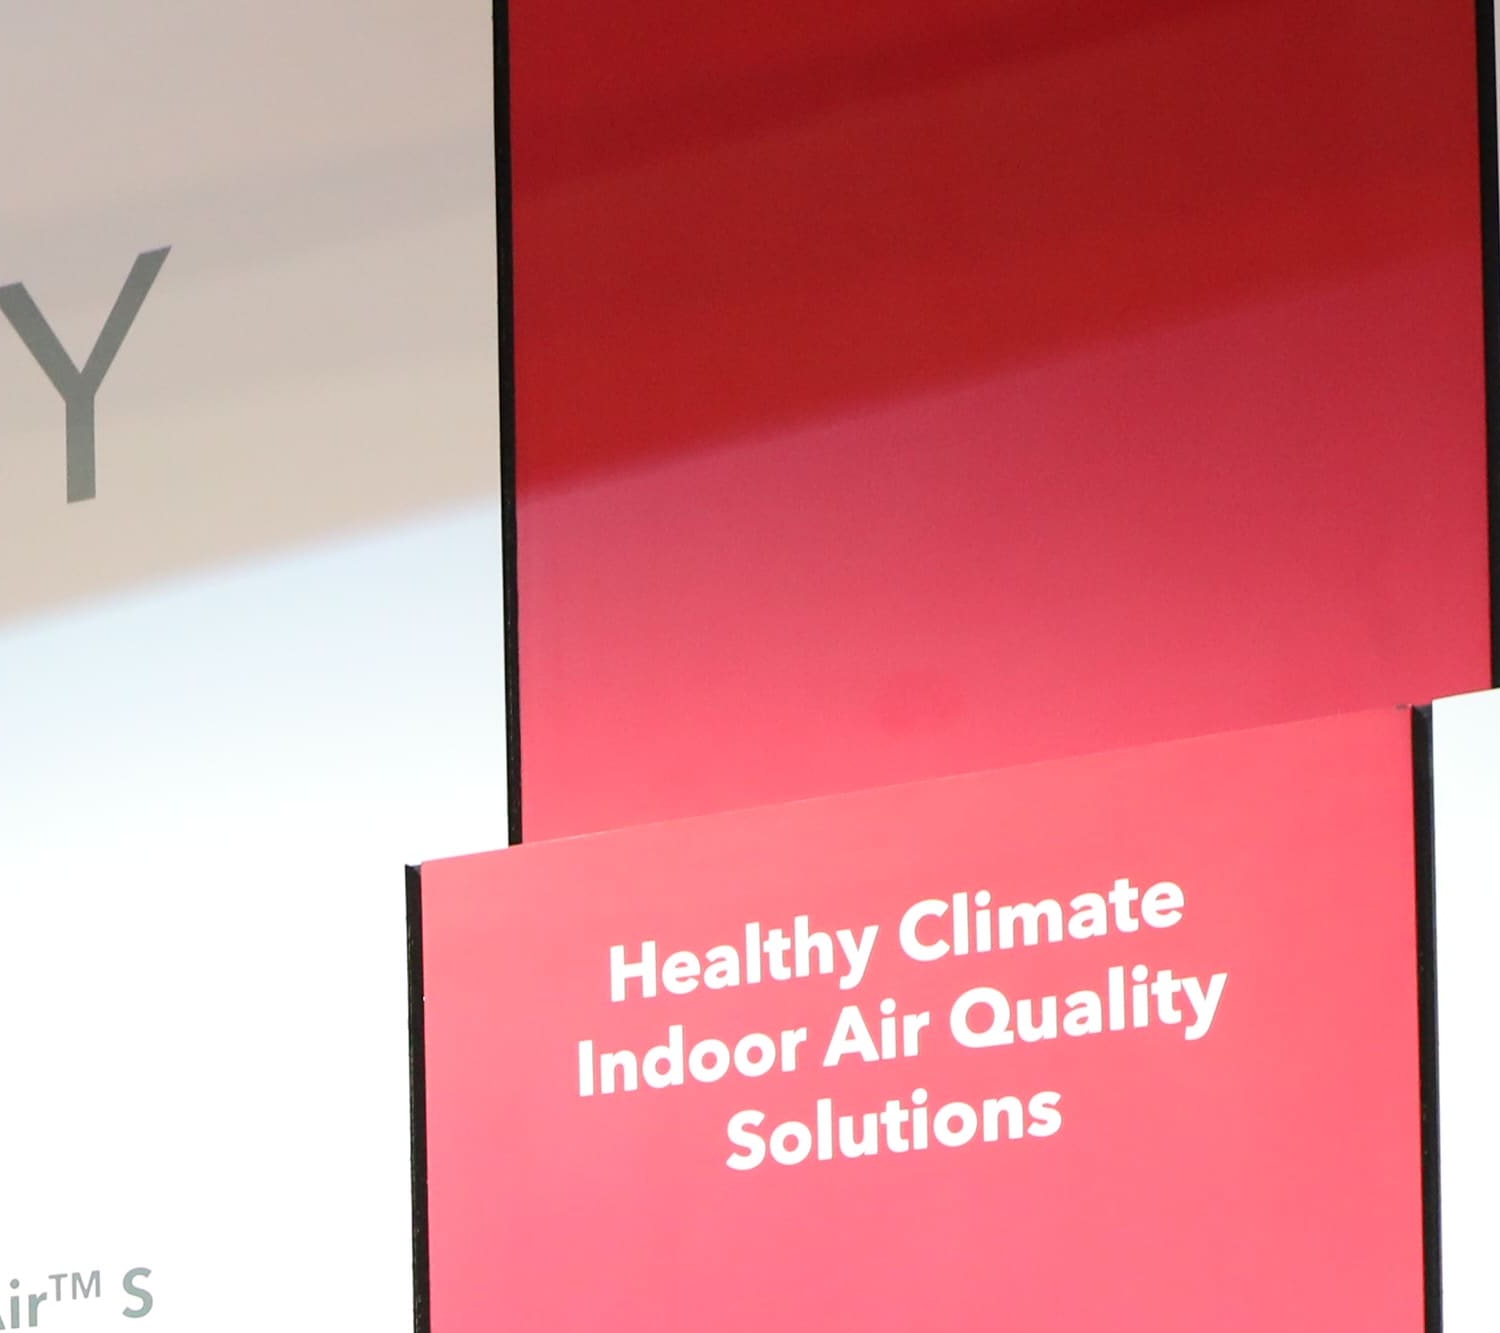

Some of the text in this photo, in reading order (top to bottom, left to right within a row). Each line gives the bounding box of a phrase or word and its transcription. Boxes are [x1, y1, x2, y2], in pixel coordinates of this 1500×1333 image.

[609, 878, 1185, 1003] Healthy Climate
[577, 963, 1229, 1097] Indoor Air Quality
[725, 1087, 1063, 1171] Solutions
[121, 1266, 154, 1319] S
